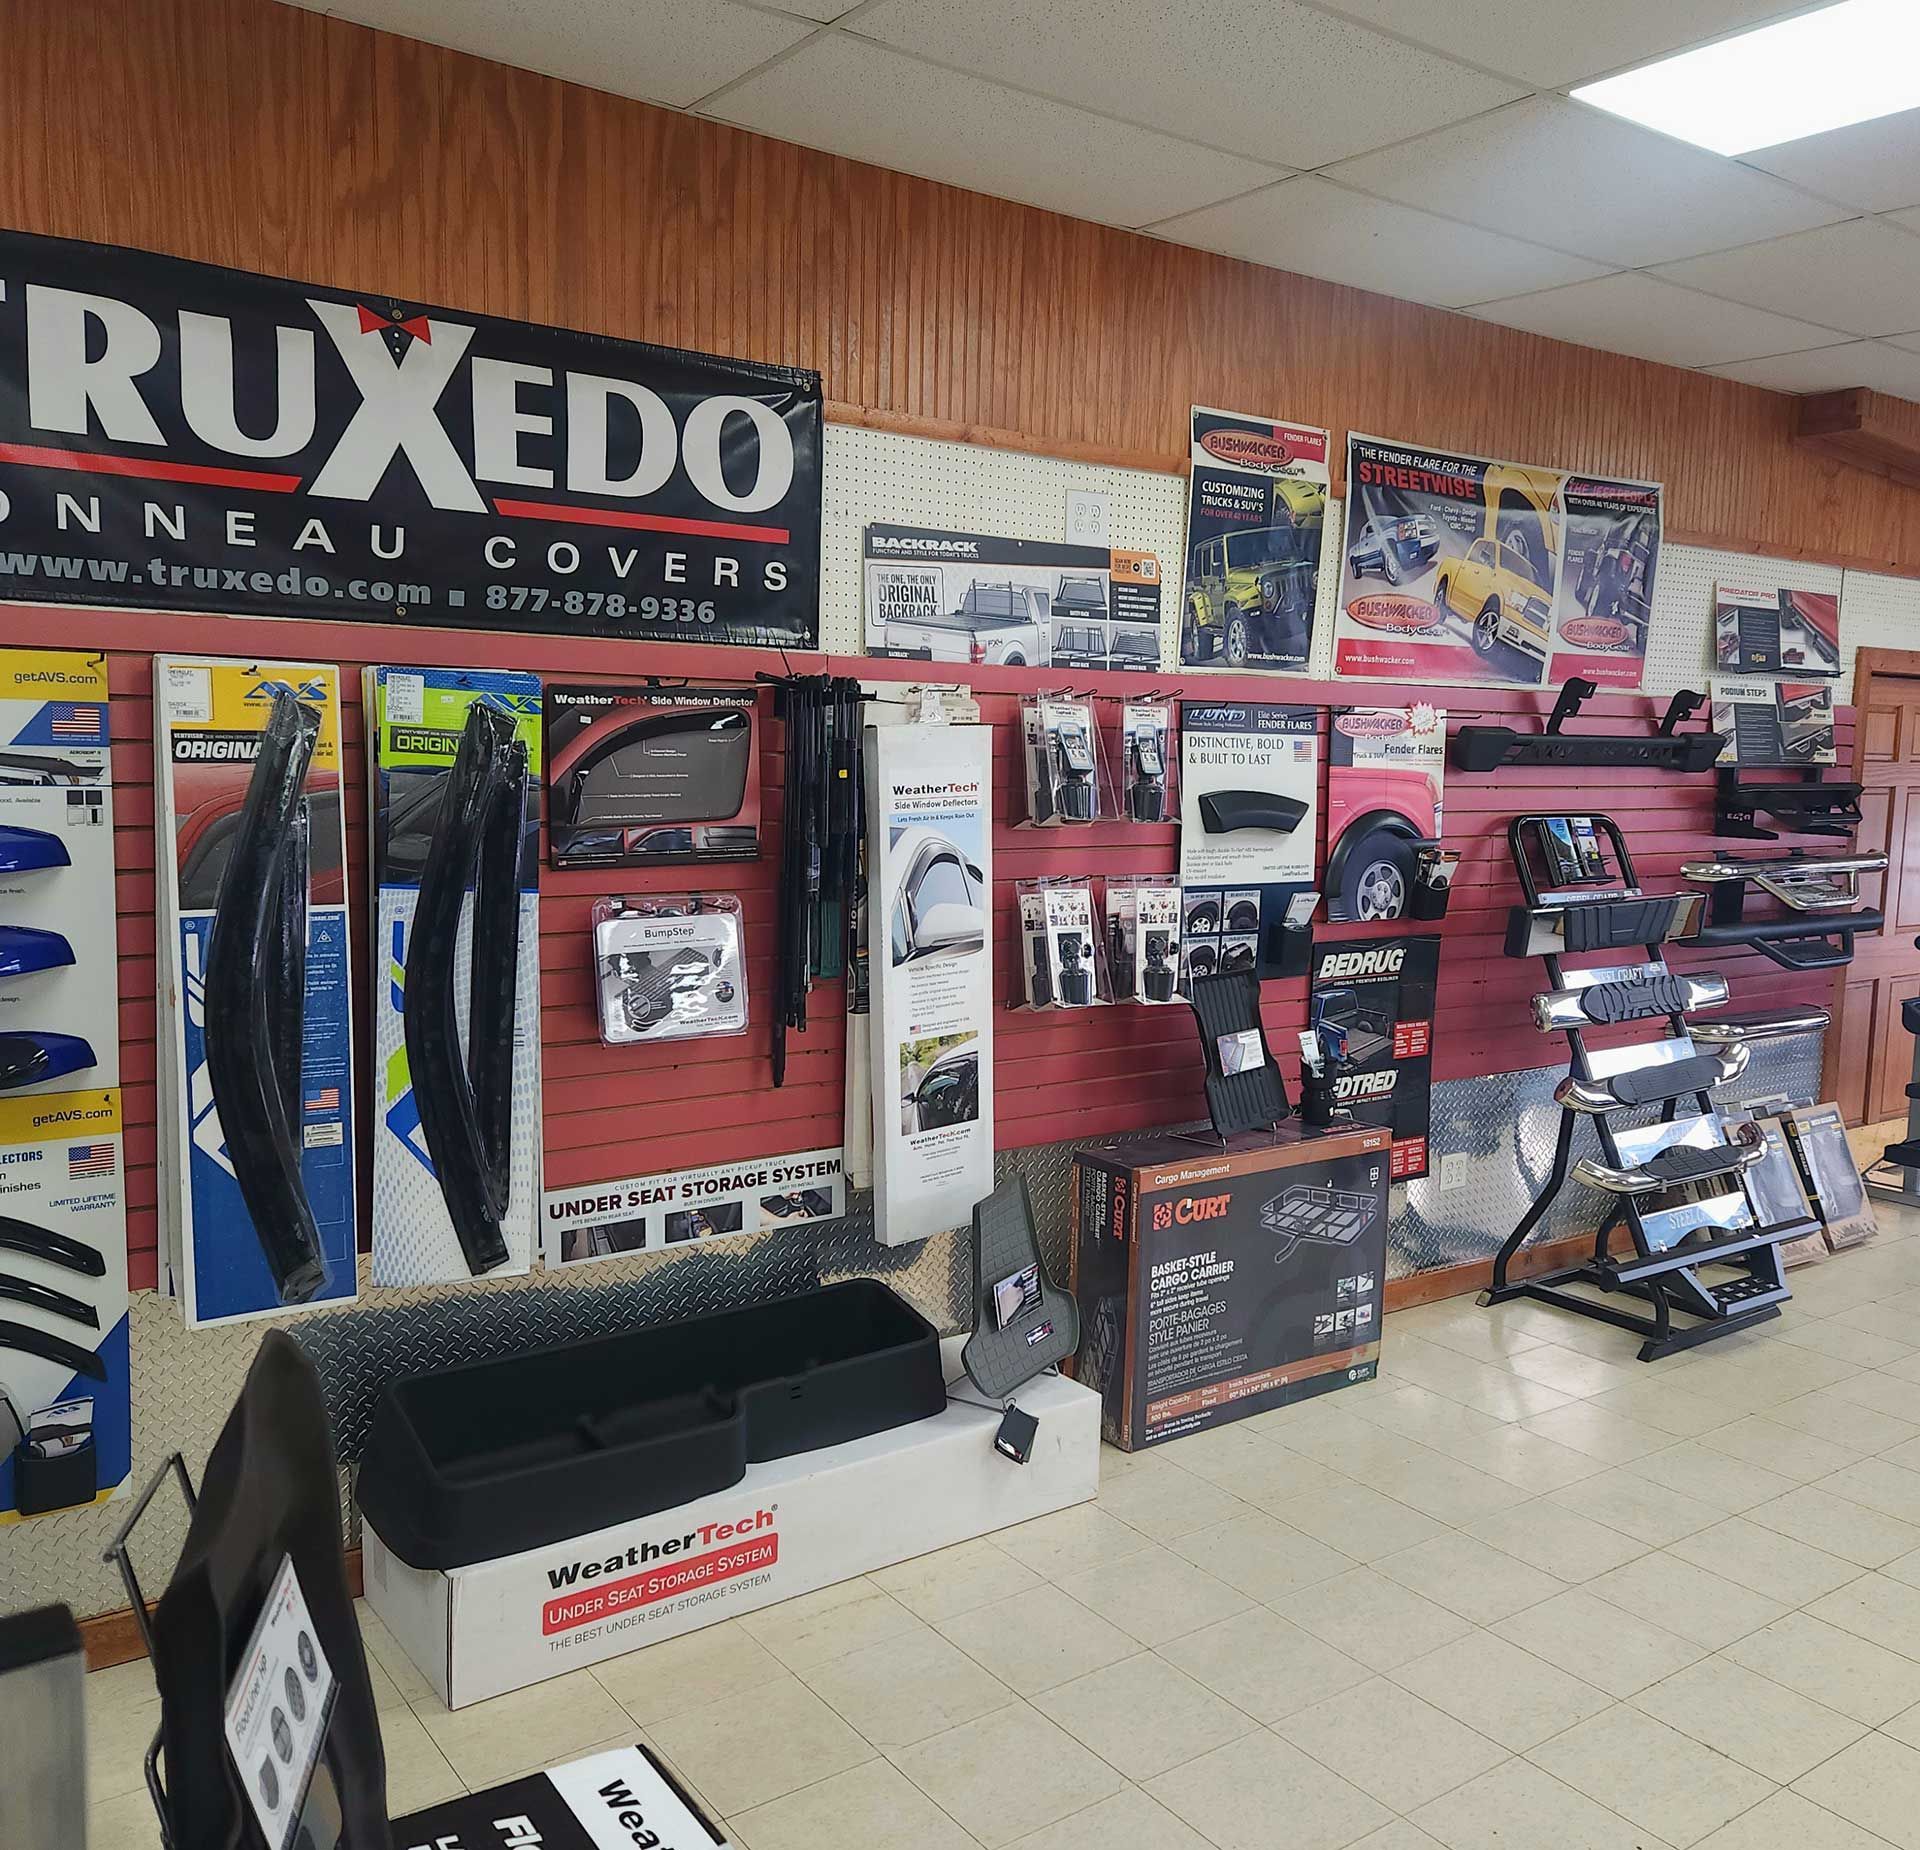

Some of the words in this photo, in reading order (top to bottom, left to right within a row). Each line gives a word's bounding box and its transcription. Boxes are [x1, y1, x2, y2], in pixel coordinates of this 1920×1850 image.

[0, 279, 796, 513] RUXEDO
[1284, 432, 1303, 442] FENDER
[1304, 436, 1321, 446] FLARES
[1210, 436, 1286, 460] BUSHWACKER
[1359, 447, 1376, 460] THE
[1378, 451, 1412, 466] FENDER
[1413, 456, 1440, 471] FLARE
[1441, 461, 1460, 473] FOR
[1461, 464, 1478, 476] THE
[1359, 461, 1477, 498] STREETWISE
[1202, 481, 1264, 499] CUSTOMIZING
[1201, 495, 1232, 508] TRUCKS
[1233, 500, 1240, 508] &
[1241, 500, 1264, 512] SUV'S
[1200, 508, 1214, 516] FOR
[1215, 510, 1233, 518] OVER
[1242, 512, 1262, 522] YEARS
[872, 536, 978, 552] BACKRACK
[484, 536, 788, 591] COVERS
[877, 574, 889, 583] THE
[890, 574, 906, 584] ONE,
[907, 574, 918, 584] THE
[920, 575, 936, 585] ONLY
[0, 553, 431, 606] www.truxedo.com
[486, 584, 716, 623] 877-878-9336
[878, 585, 937, 603] ORIGINAL
[1719, 587, 1759, 597] PREDATOR
[879, 603, 937, 618] BACKRACK
[1358, 601, 1432, 620] BUSHWACKER
[1566, 624, 1622, 638] BUSHWACKER
[1586, 641, 1630, 652] BodyGear
[1345, 654, 1415, 665] www.bushwacker.com
[14, 671, 98, 684] getAVS.com
[554, 694, 646, 705] WeatherTech
[651, 696, 672, 706] Side
[674, 696, 711, 706] Window
[713, 697, 754, 706] Deflector
[1720, 687, 1745, 695] PODIUM
[1746, 688, 1767, 697] STEPS
[1189, 709, 1246, 721] LUND
[1257, 710, 1270, 718] Elite
[1271, 711, 1288, 720] Series
[1258, 720, 1286, 729] FENDER
[1287, 721, 1312, 730] FLARES
[1342, 718, 1403, 729] BUSHWACKER
[175, 741, 262, 759] ORIGINA
[397, 735, 459, 753] ORIGIN
[1189, 737, 1253, 751] DISTINCTIVE,
[1257, 738, 1284, 750] BOLD
[1384, 743, 1417, 754] Fender
[1418, 744, 1443, 754] Flares
[1189, 753, 1197, 764] &
[1200, 753, 1228, 764] BUILT
[1231, 753, 1245, 764] TO
[1249, 754, 1271, 765] LAST
[892, 782, 979, 795] WeatherTech
[912, 800, 941, 808] Window
[942, 799, 978, 807] Deflectors
[644, 927, 695, 939] BumpStep
[1319, 948, 1404, 979] BEDRUG
[33, 1109, 113, 1127] getAVS.com
[1362, 1137, 1381, 1148] 18152
[0, 1150, 43, 1165] ECTORS
[615, 1182, 645, 1191] CUSTOM
[663, 1176, 677, 1184] FOR
[680, 1171, 718, 1180] VIRTUALLY
[737, 1164, 762, 1172] PICKUP
[765, 1160, 786, 1168] TRUCK
[1155, 1174, 1179, 1185] Cargo
[1180, 1164, 1230, 1180] Management
[0, 1182, 41, 1194] inishes
[549, 1194, 622, 1219] UNDER
[627, 1186, 676, 1207] SEAT
[682, 1171, 767, 1198] STORAGE
[772, 1159, 841, 1183] SYSTEM
[50, 1197, 80, 1207] LIMITED
[82, 1192, 116, 1203] LIFETIME
[71, 1201, 117, 1212] WARRANTY
[1113, 1195, 1125, 1240] CURT
[1175, 1194, 1232, 1225] CURT
[1151, 1251, 1217, 1279] BASKET-STYLE
[1150, 1271, 1189, 1292] CARGO
[1190, 1260, 1234, 1280] CARRIER
[1149, 1300, 1227, 1333] PORTE-BAGAGES
[1148, 1327, 1174, 1346] STYLE
[1176, 1318, 1210, 1337] PANIER
[549, 1597, 603, 1625] UNDER
[608, 1583, 646, 1608] SEAT
[648, 1562, 714, 1594] STORAGE
[717, 1545, 773, 1573] SYSTEM
[549, 1637, 572, 1652] THE
[574, 1626, 603, 1645] BEST
[606, 1613, 646, 1635] UNDER
[648, 1604, 676, 1621] SEAT
[677, 1587, 728, 1612] STORAGE
[729, 1572, 772, 1594] SYSTEM
